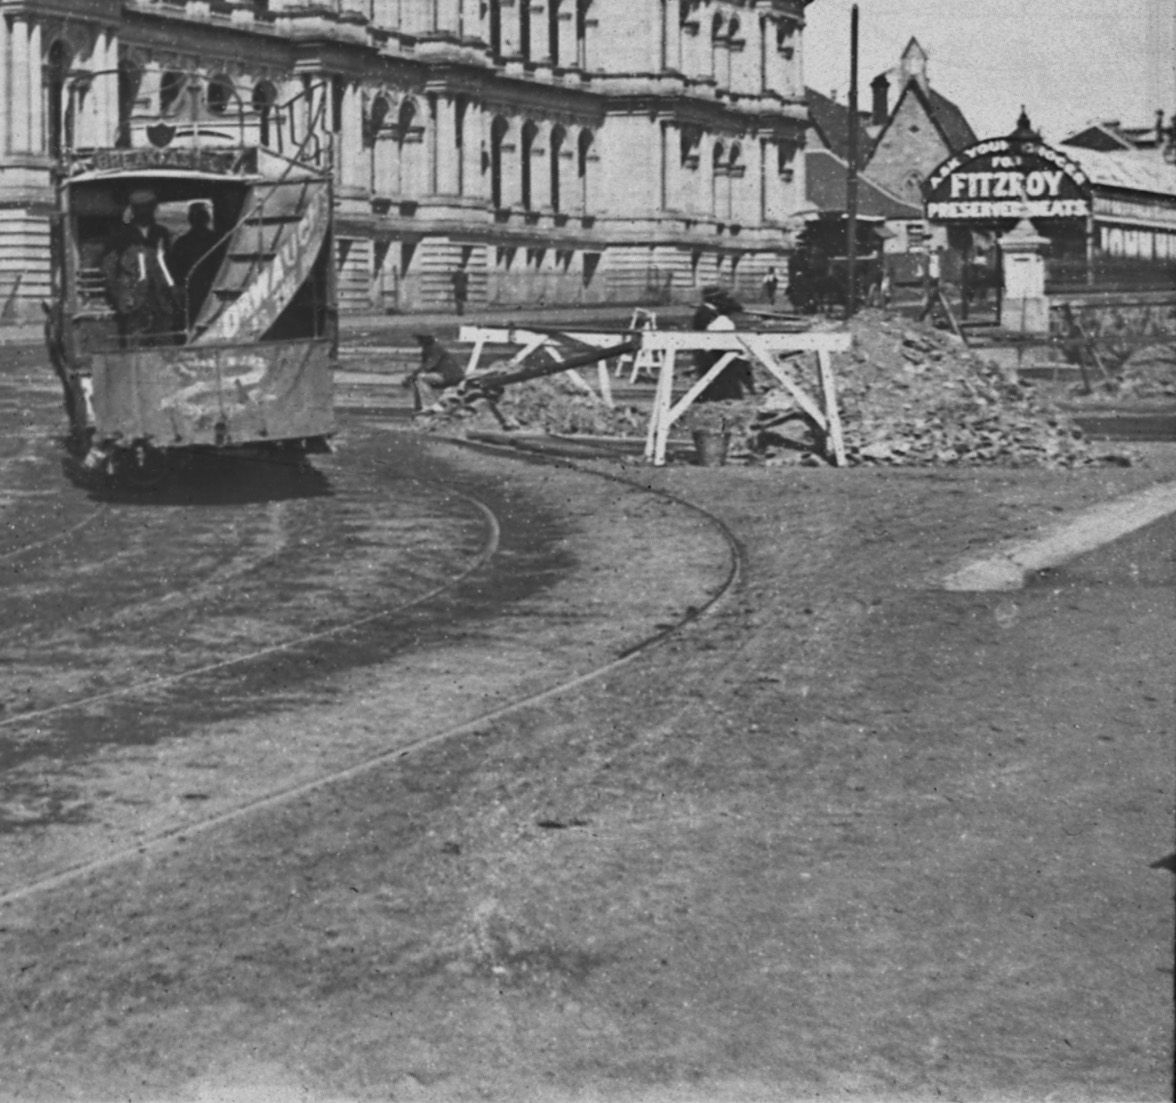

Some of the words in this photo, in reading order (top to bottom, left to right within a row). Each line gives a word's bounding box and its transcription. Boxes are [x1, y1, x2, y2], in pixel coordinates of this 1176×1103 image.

[930, 158, 961, 189] ASK
[964, 140, 1009, 158] YOUR
[991, 156, 1022, 168] FOR
[950, 170, 1063, 198] FITZROY
